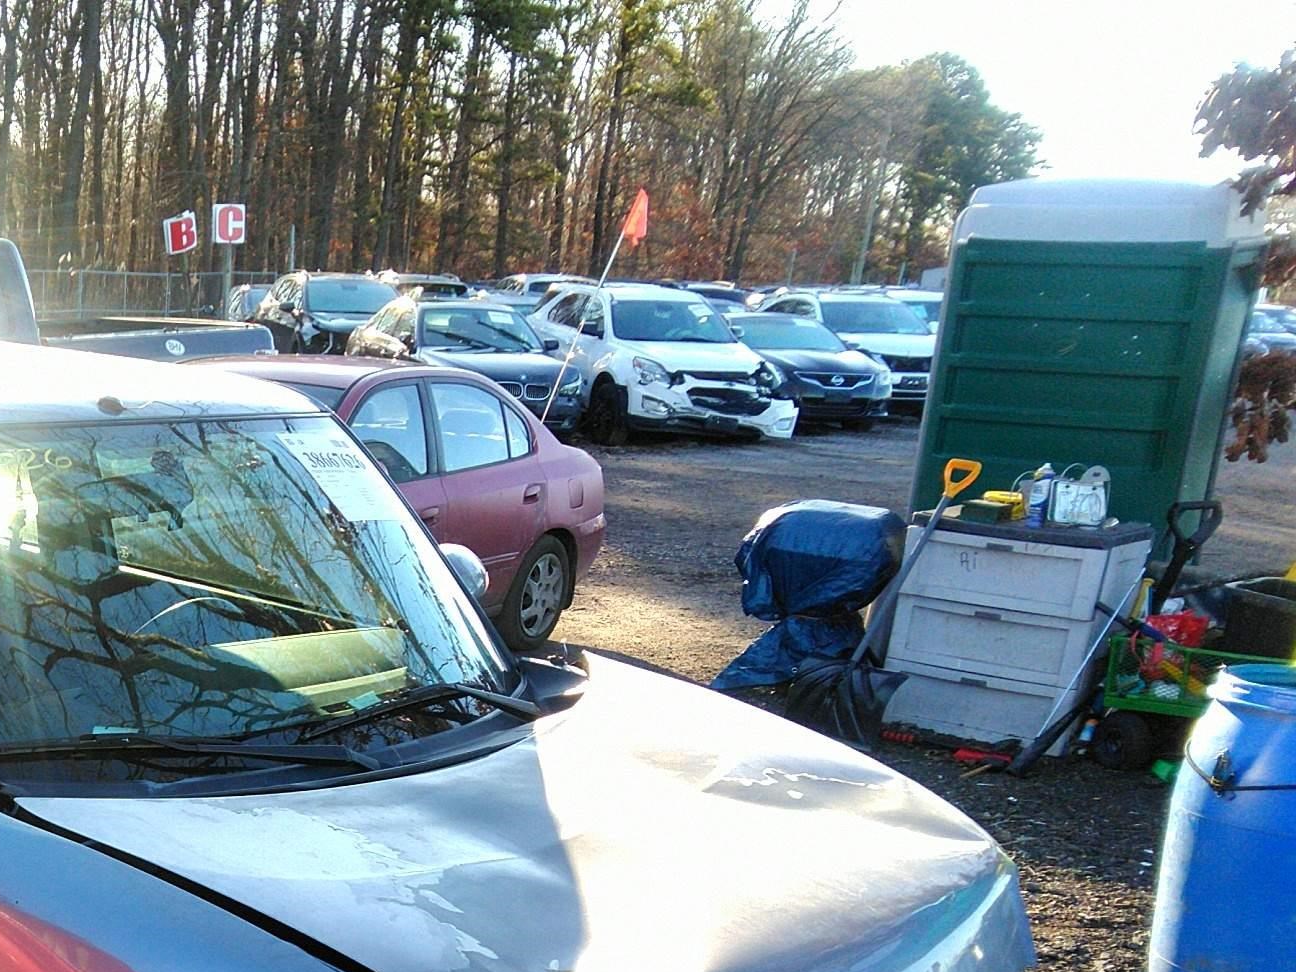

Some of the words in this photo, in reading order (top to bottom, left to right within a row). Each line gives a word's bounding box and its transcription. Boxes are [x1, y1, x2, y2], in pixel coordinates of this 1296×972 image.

[170, 216, 196, 253] B
[218, 206, 243, 241] C
[302, 452, 366, 470] 38667626
